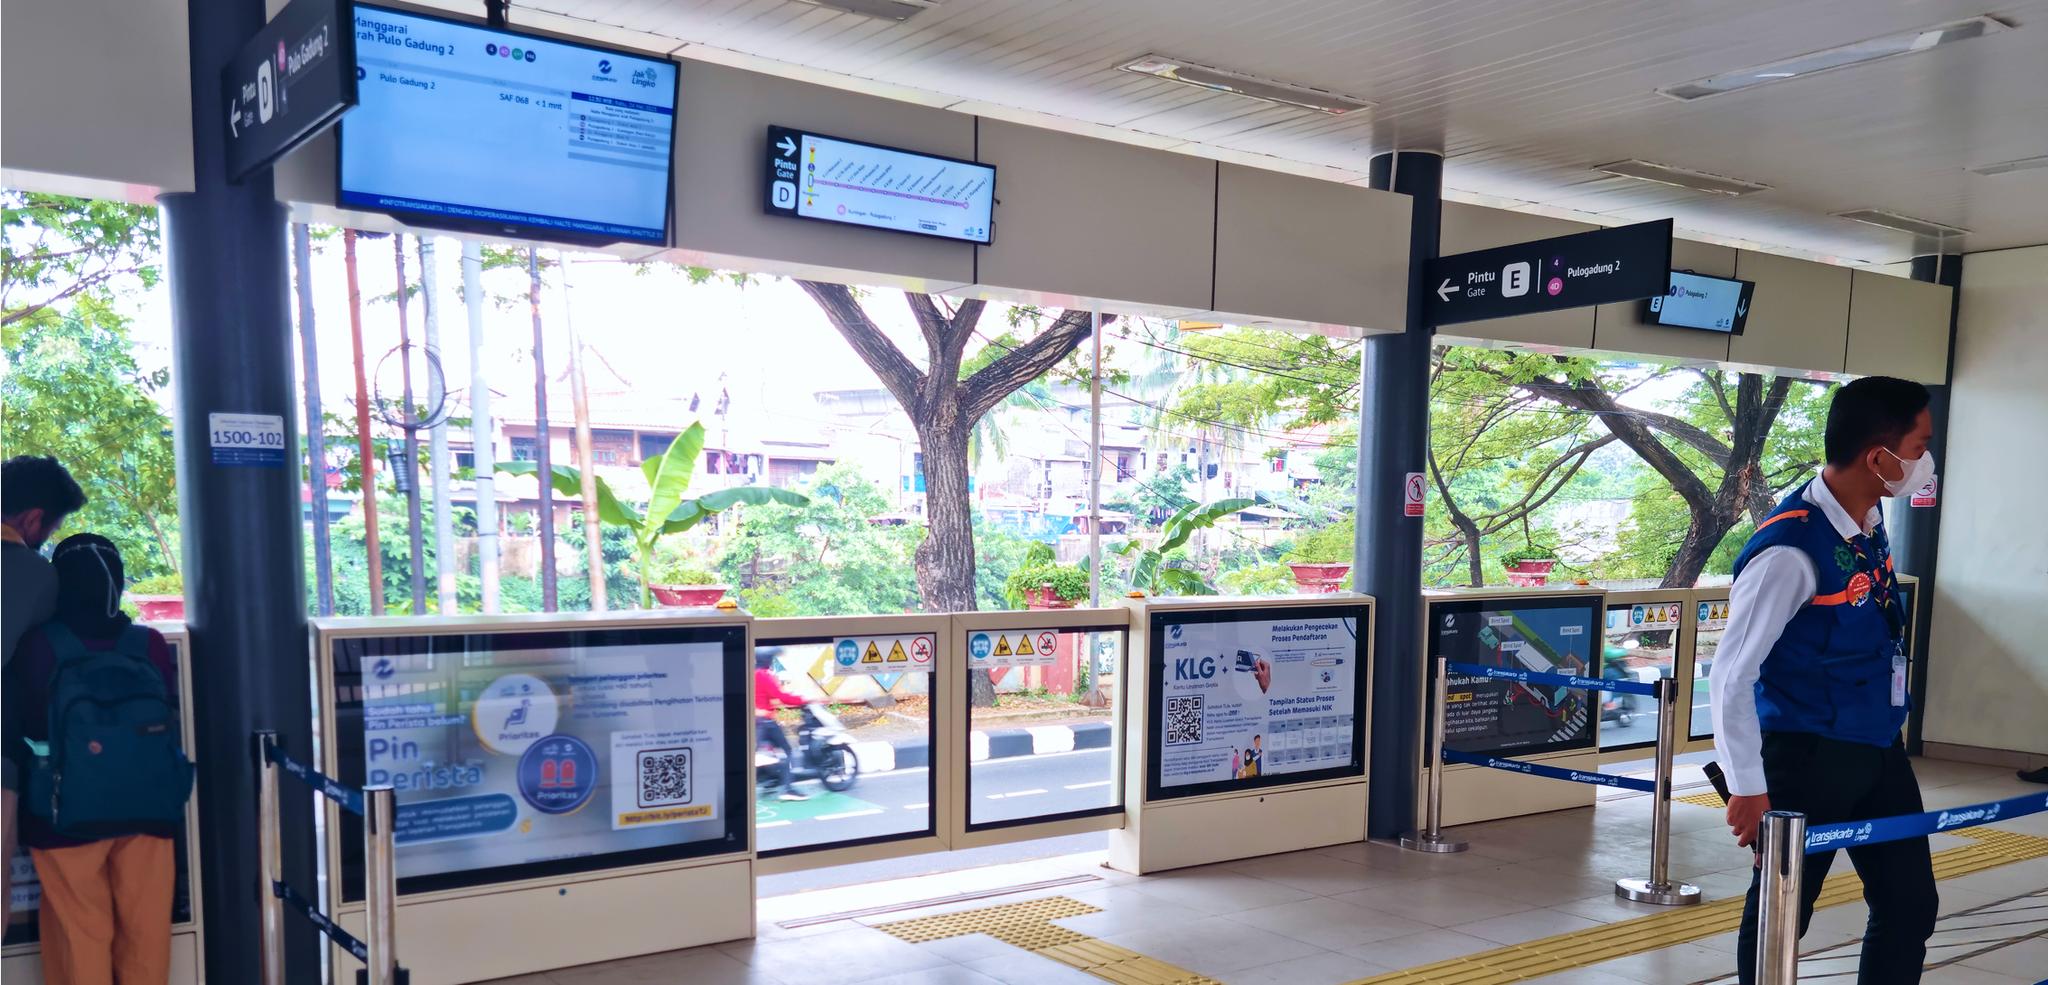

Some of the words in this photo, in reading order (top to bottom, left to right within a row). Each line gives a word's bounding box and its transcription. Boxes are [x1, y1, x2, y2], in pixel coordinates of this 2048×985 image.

[287, 48, 302, 77] Pulo
[301, 32, 324, 70] Gadung
[323, 25, 329, 48] 2
[377, 34, 402, 46] Pulo
[405, 38, 445, 56] Gadung
[449, 45, 455, 55] 2
[380, 73, 397, 84] Pulo
[399, 76, 428, 90] Gadung
[430, 81, 436, 89] 2
[262, 75, 268, 110] D
[499, 93, 513, 101] SAF
[774, 158, 797, 171] Pintu
[777, 168, 795, 179] Gate
[779, 186, 790, 202] D
[1553, 258, 1559, 267] 4
[1567, 260, 1613, 278] Pulogadung
[1614, 259, 1620, 272] 2
[1467, 270, 1495, 285] Pintu
[1510, 269, 1520, 289] E
[1467, 286, 1486, 298] Gate
[1653, 298, 1659, 309] E
[213, 430, 282, 446] 1500-102
[1271, 624, 1304, 632] Melakukan
[1304, 623, 1339, 632] Pengecekan
[1271, 634, 1292, 642] Proses
[1292, 633, 1328, 641] Pendaftaran
[1175, 656, 1216, 680] KLG
[1269, 697, 1296, 706] Tampilan
[1316, 695, 1335, 703] Proses
[1268, 708, 1292, 716] Setelah
[1292, 705, 1321, 714] Memasuki
[1321, 704, 1333, 712] NIK
[368, 719, 386, 729] Pin
[388, 718, 425, 728] Perista
[369, 735, 419, 762] Pin
[370, 763, 481, 790] Perista
[537, 791, 578, 801] Prioritas
[1810, 828, 1854, 843] transjakarta
